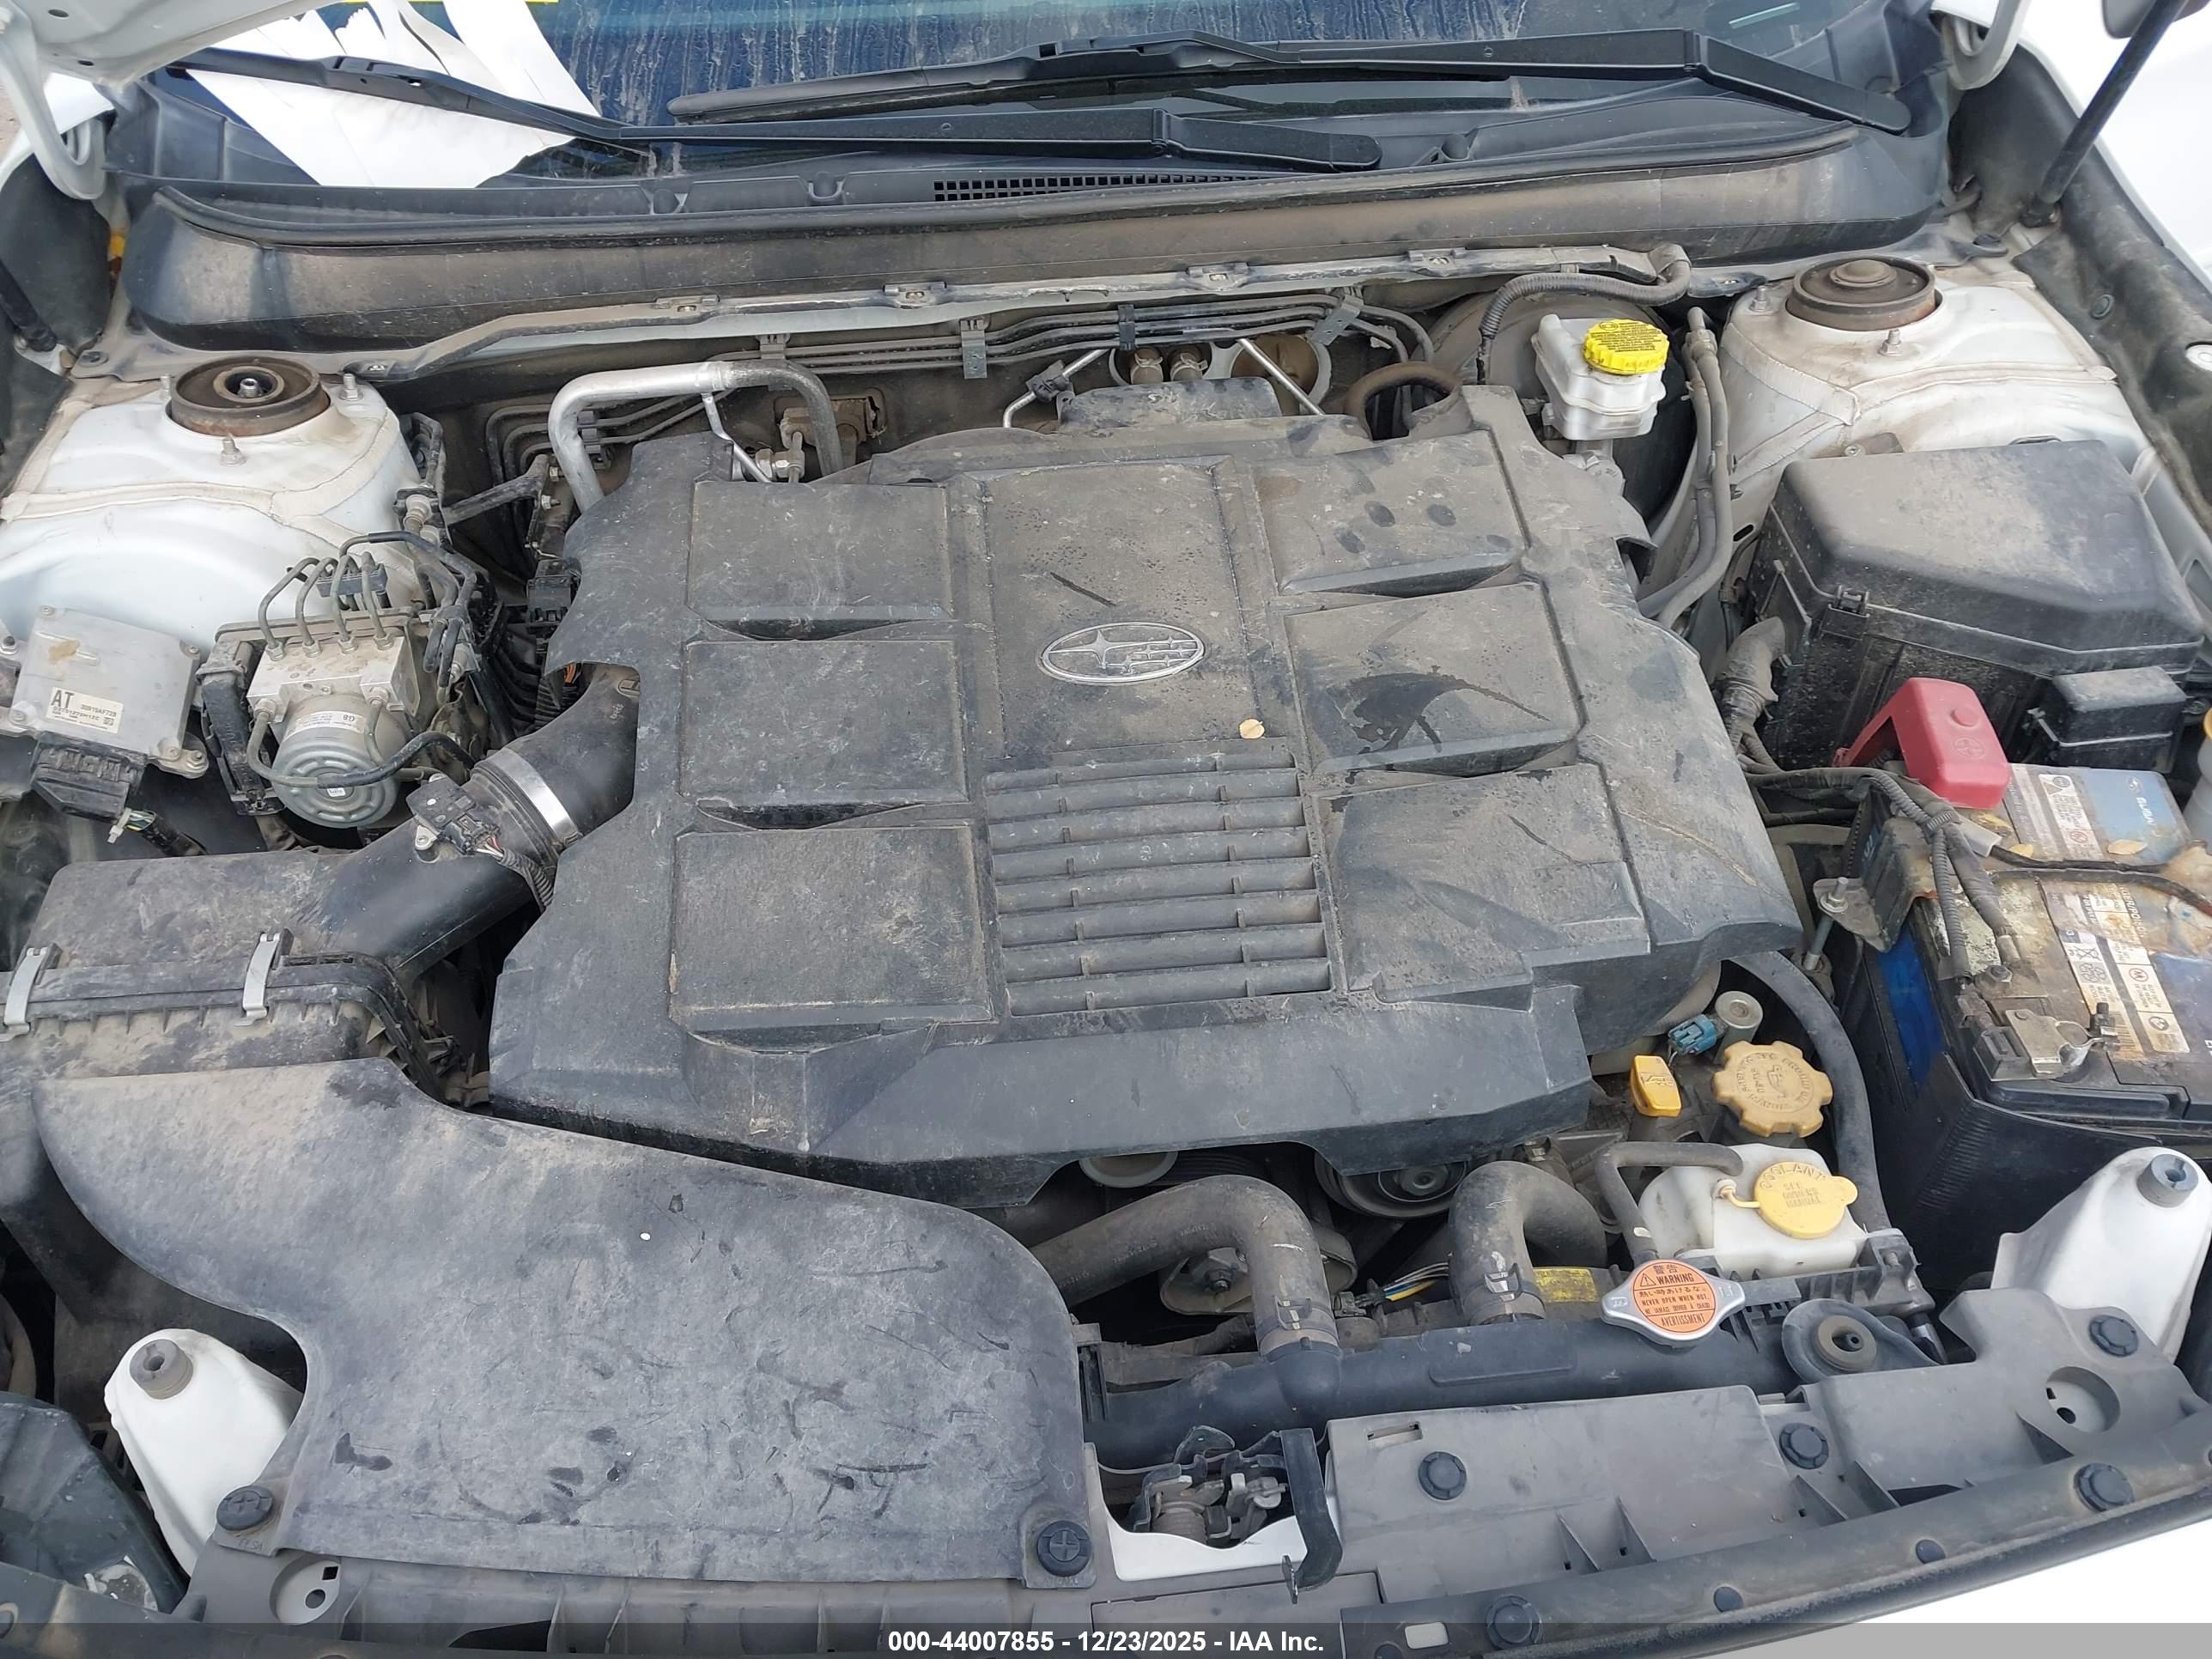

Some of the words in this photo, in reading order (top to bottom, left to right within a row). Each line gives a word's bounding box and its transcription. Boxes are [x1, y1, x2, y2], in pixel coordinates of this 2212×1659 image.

[51, 690, 74, 709] AT
[1759, 1163, 1827, 1190] COOLANT
[1656, 1273, 1695, 1285] WARNING
[1662, 1296, 1677, 1304] OPEN
